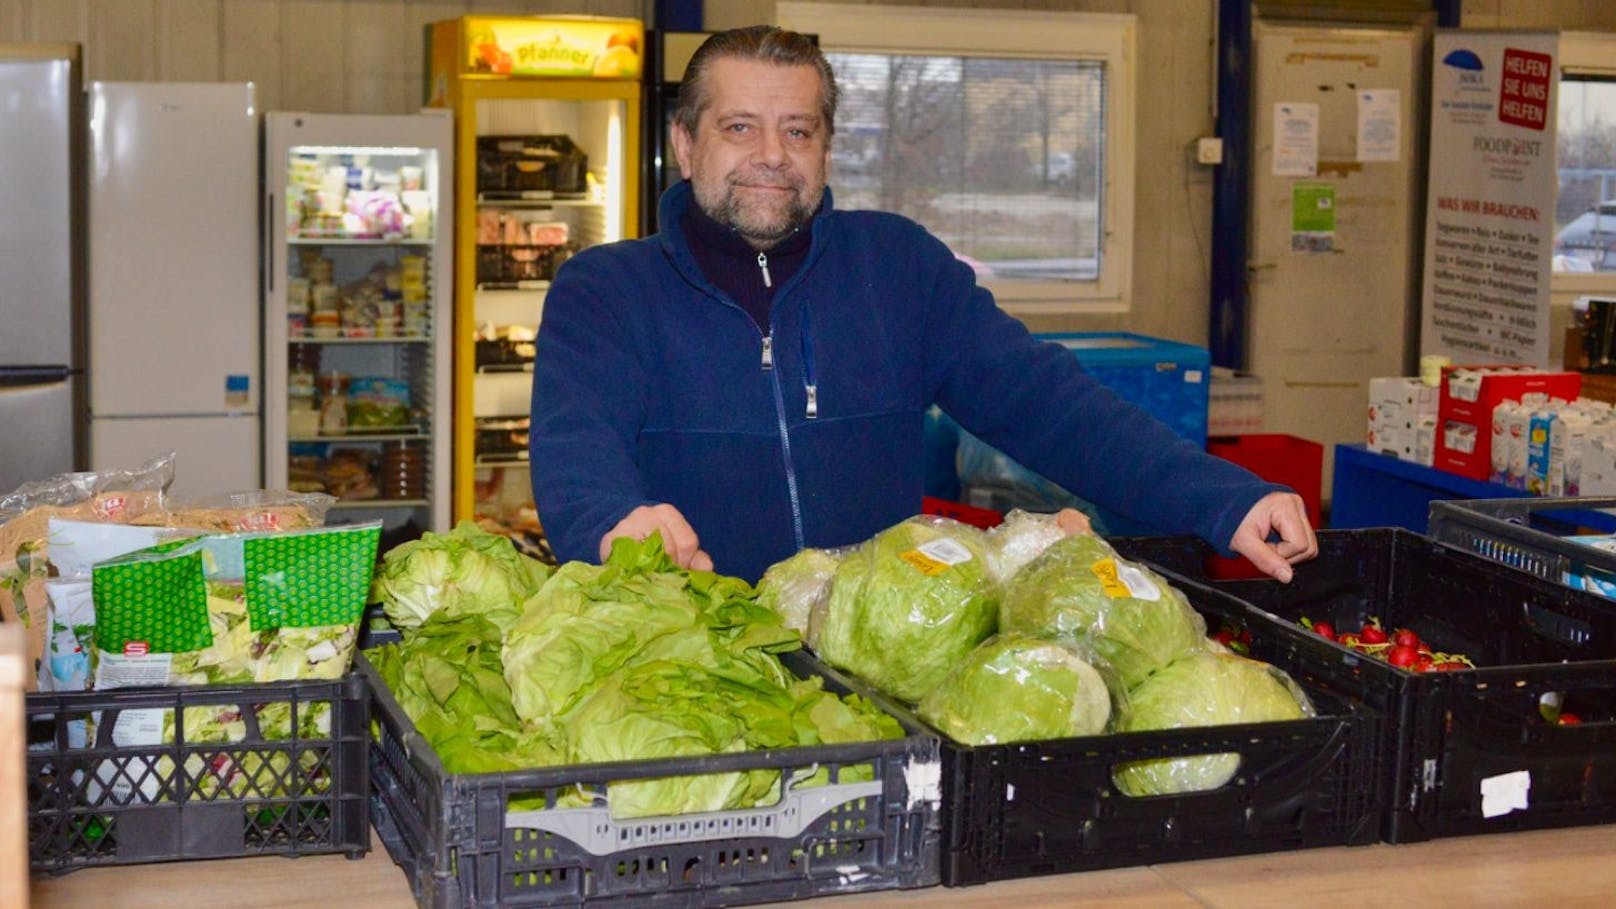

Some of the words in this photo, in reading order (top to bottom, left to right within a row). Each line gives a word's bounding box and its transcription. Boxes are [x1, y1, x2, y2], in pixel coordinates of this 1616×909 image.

[517, 42, 589, 64] pfanner
[1505, 55, 1548, 78] HELFEN
[1504, 78, 1520, 96] SIE
[1522, 81, 1546, 101] UNS
[1503, 100, 1544, 123] HELFEN
[1438, 197, 1459, 212] WAS
[1461, 199, 1480, 214] WIR
[1483, 201, 1541, 221] BRAUCHEN:
[1488, 245, 1500, 256] Art
[1493, 262, 1538, 283] Babynahrung
